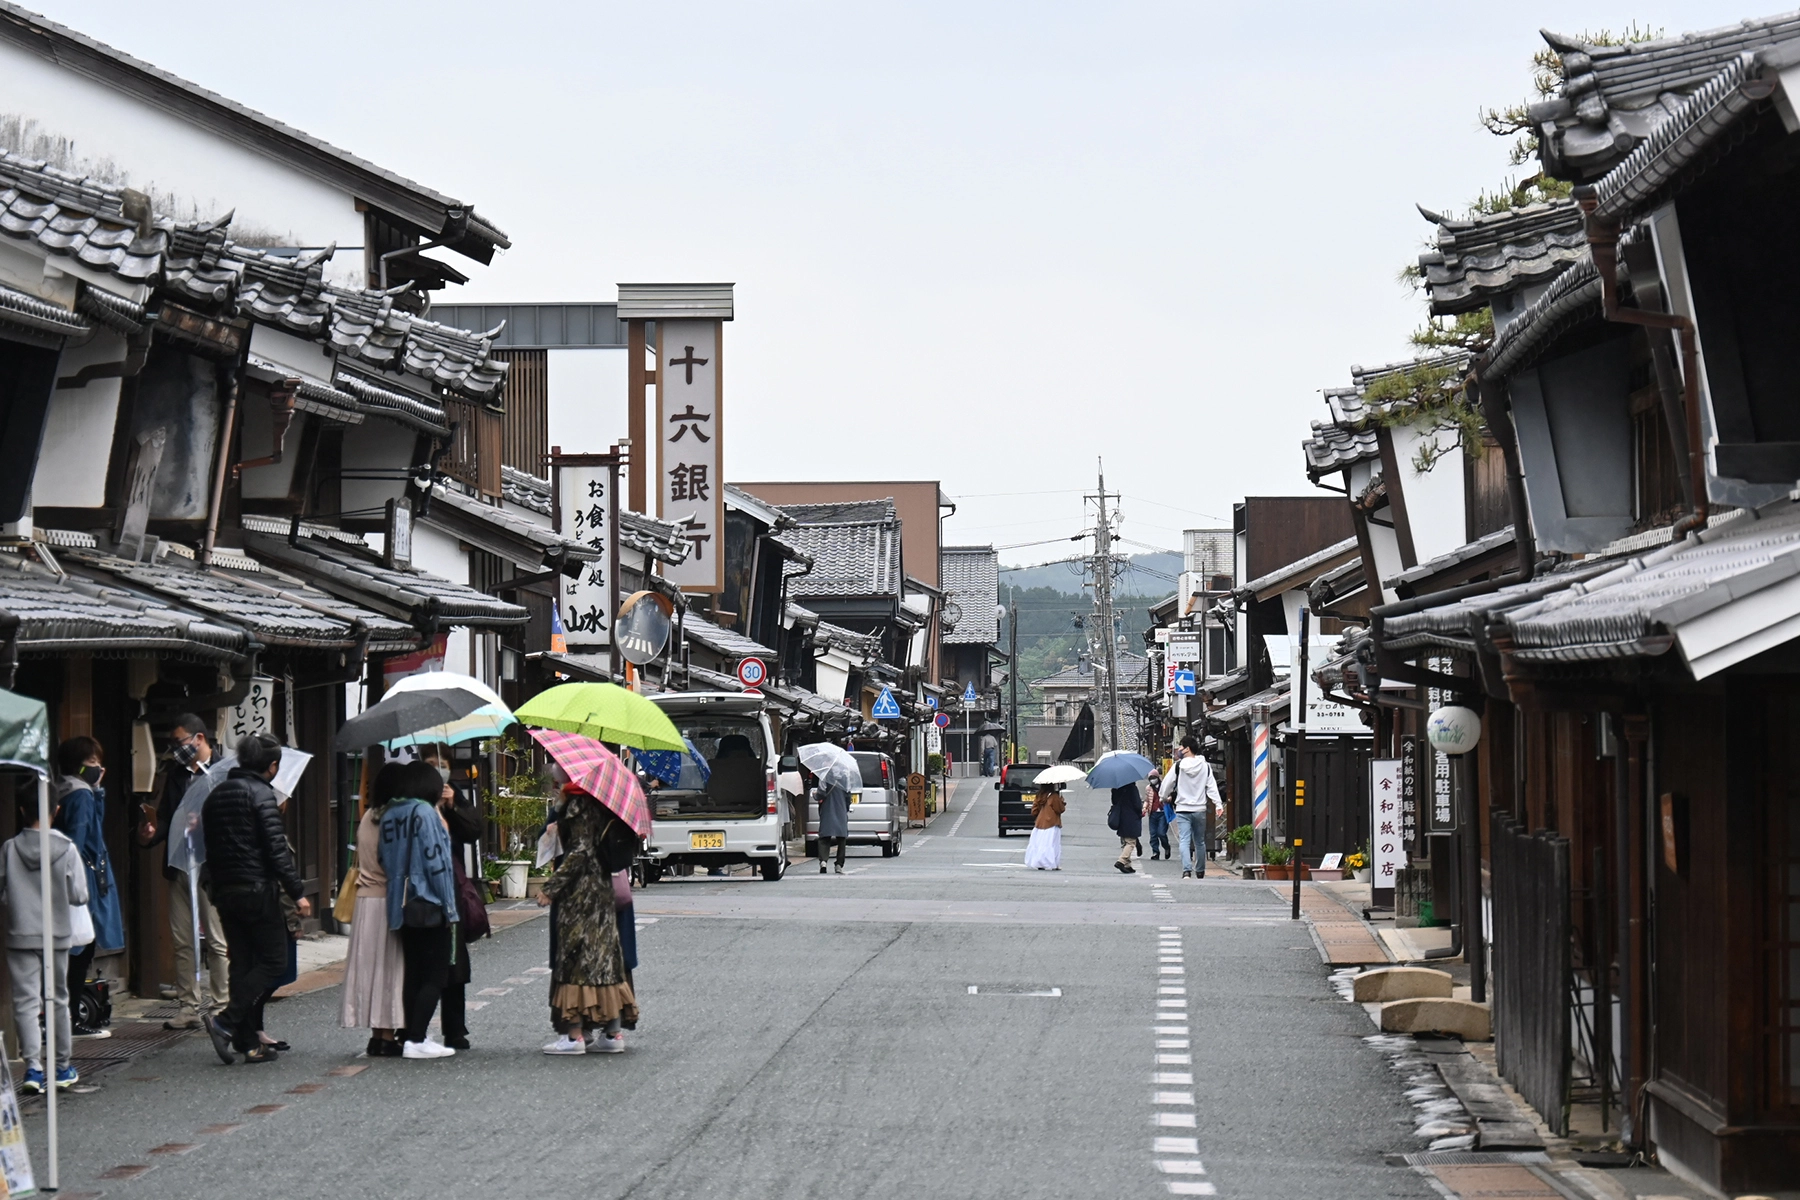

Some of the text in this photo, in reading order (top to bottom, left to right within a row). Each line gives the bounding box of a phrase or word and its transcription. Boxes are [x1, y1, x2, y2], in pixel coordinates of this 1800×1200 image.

[668, 346, 711, 560] 十六銀行
[574, 510, 584, 546] うど
[563, 604, 608, 634] 山水
[744, 665, 760, 679] 30
